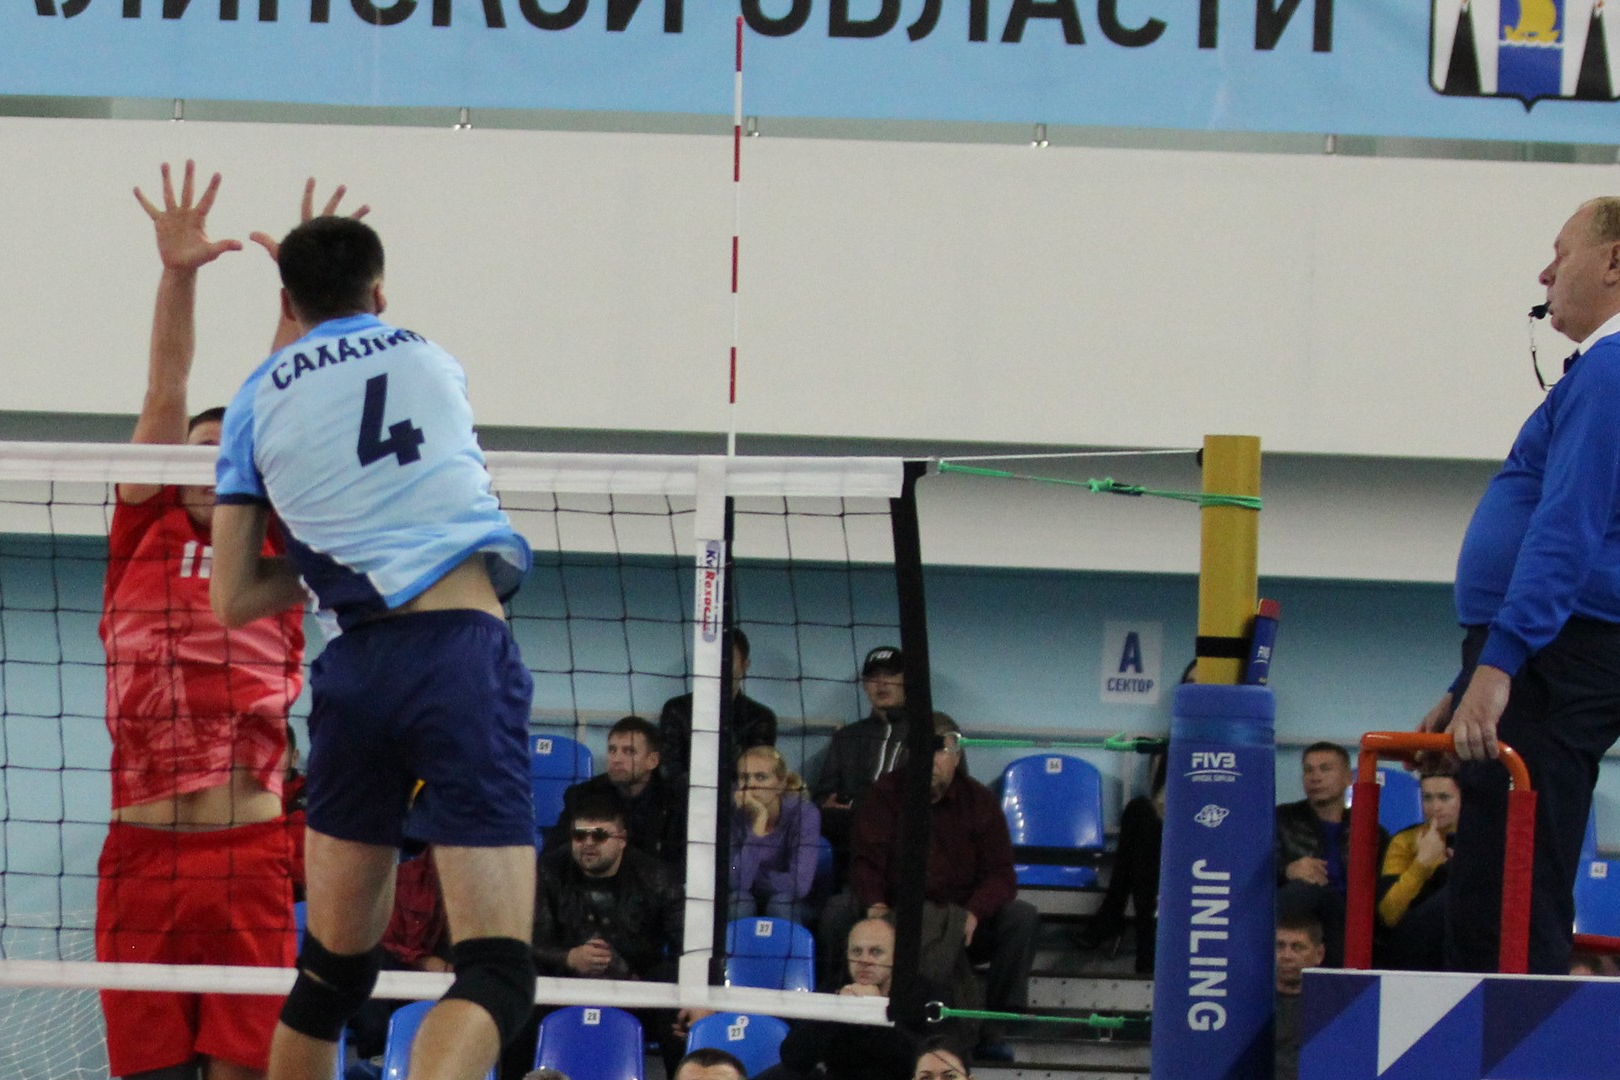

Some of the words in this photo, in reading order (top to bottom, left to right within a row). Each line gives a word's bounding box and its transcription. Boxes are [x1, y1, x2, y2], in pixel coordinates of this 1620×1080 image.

[356, 372, 425, 468] 4
[1118, 631, 1144, 674] А
[1106, 677, 1155, 694] СЕКТОР
[1191, 752, 1237, 769] FIVB
[1188, 859, 1231, 1033] JINLING
